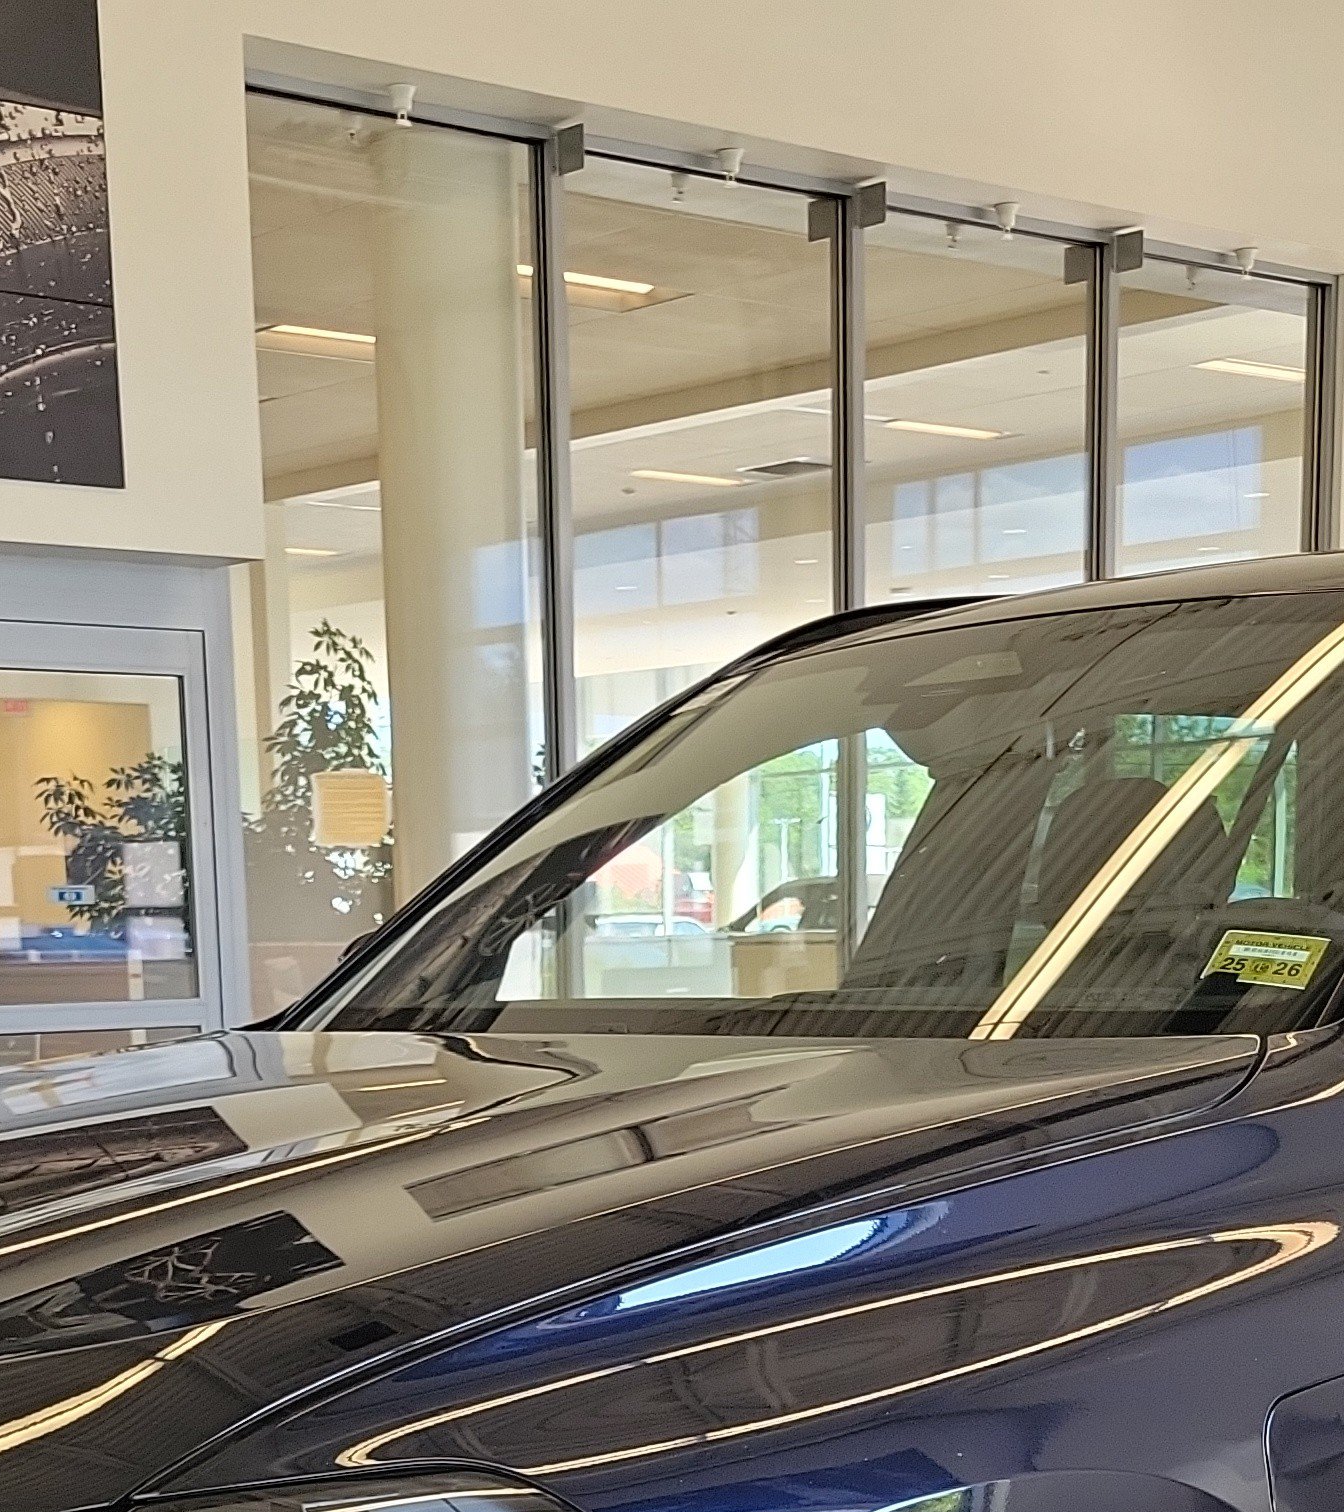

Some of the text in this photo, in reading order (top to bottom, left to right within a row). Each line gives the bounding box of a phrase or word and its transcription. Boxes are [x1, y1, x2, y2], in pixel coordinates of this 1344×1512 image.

[1236, 940, 1270, 948] MOTOR
[1219, 957, 1249, 972] 25
[1272, 961, 1303, 977] 26
